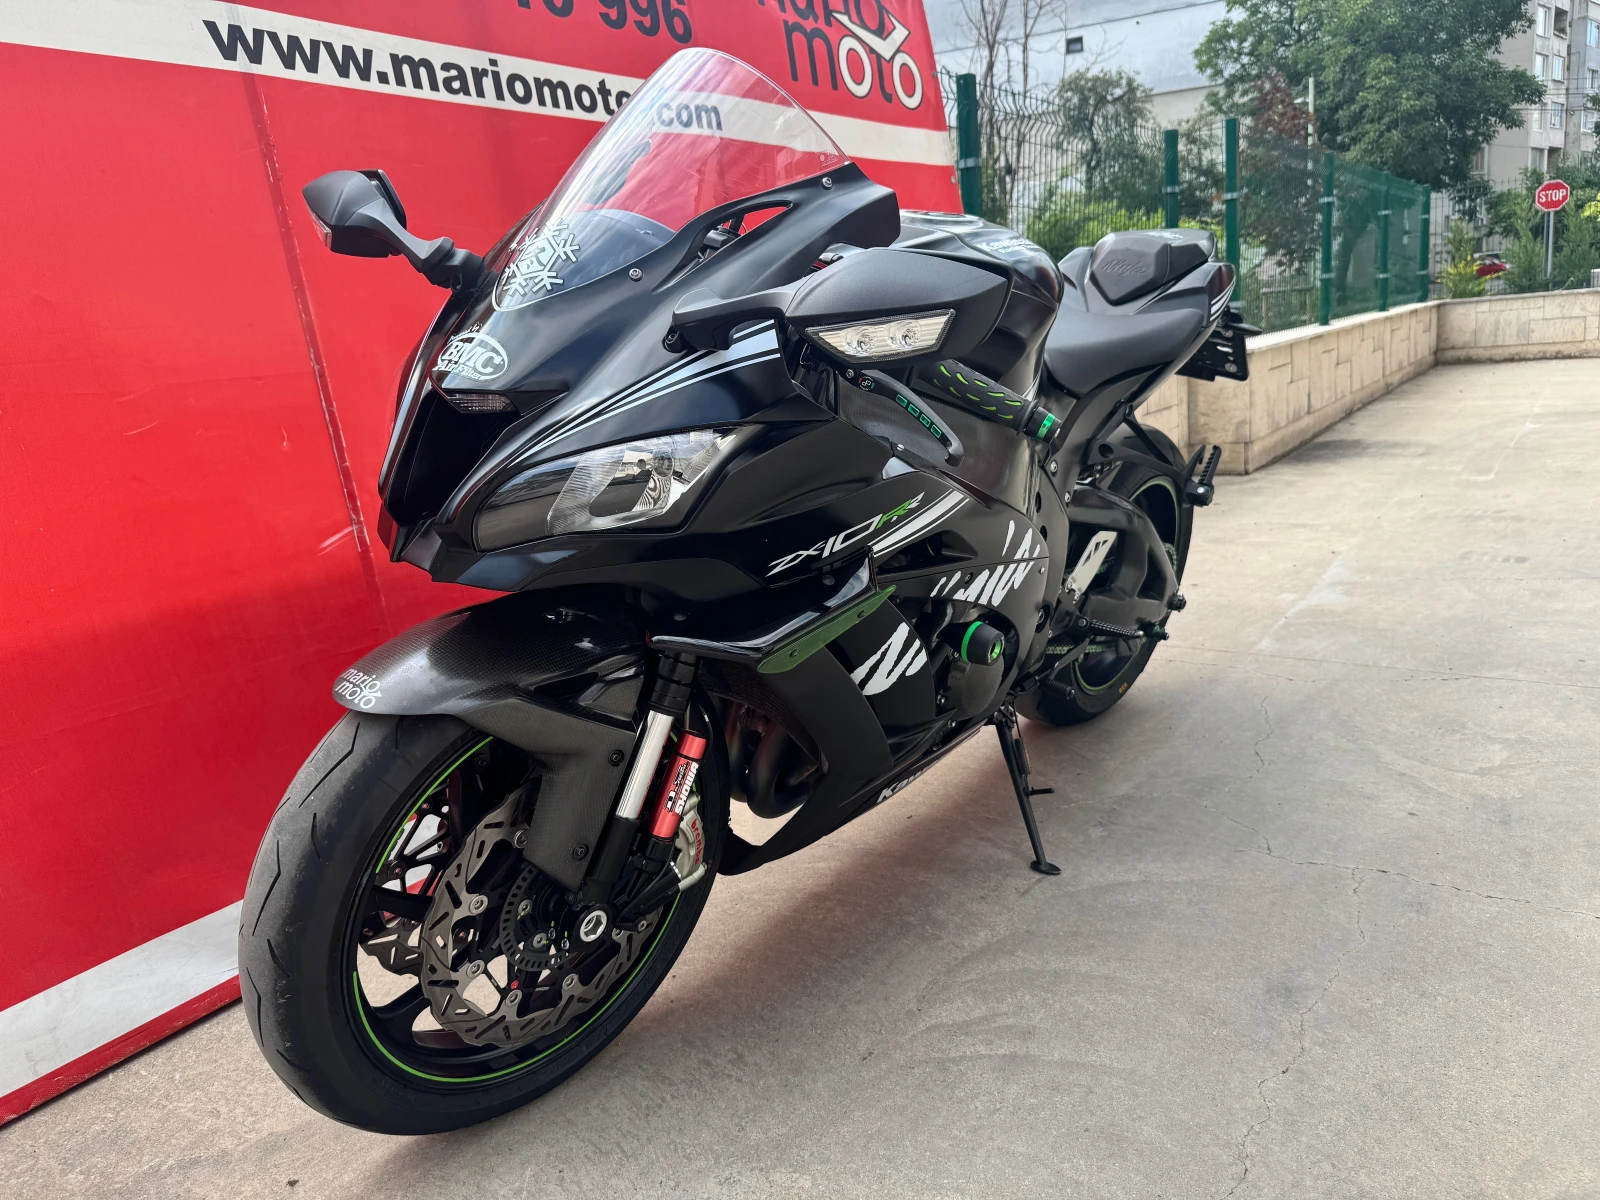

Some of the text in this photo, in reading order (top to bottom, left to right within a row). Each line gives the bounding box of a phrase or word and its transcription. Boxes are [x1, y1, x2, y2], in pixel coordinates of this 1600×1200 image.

[783, 19, 923, 111] moto
[1539, 189, 1567, 203] STOP
[441, 341, 504, 374] BMC
[340, 668, 381, 693] mario
[674, 761, 699, 815] SHOWA
